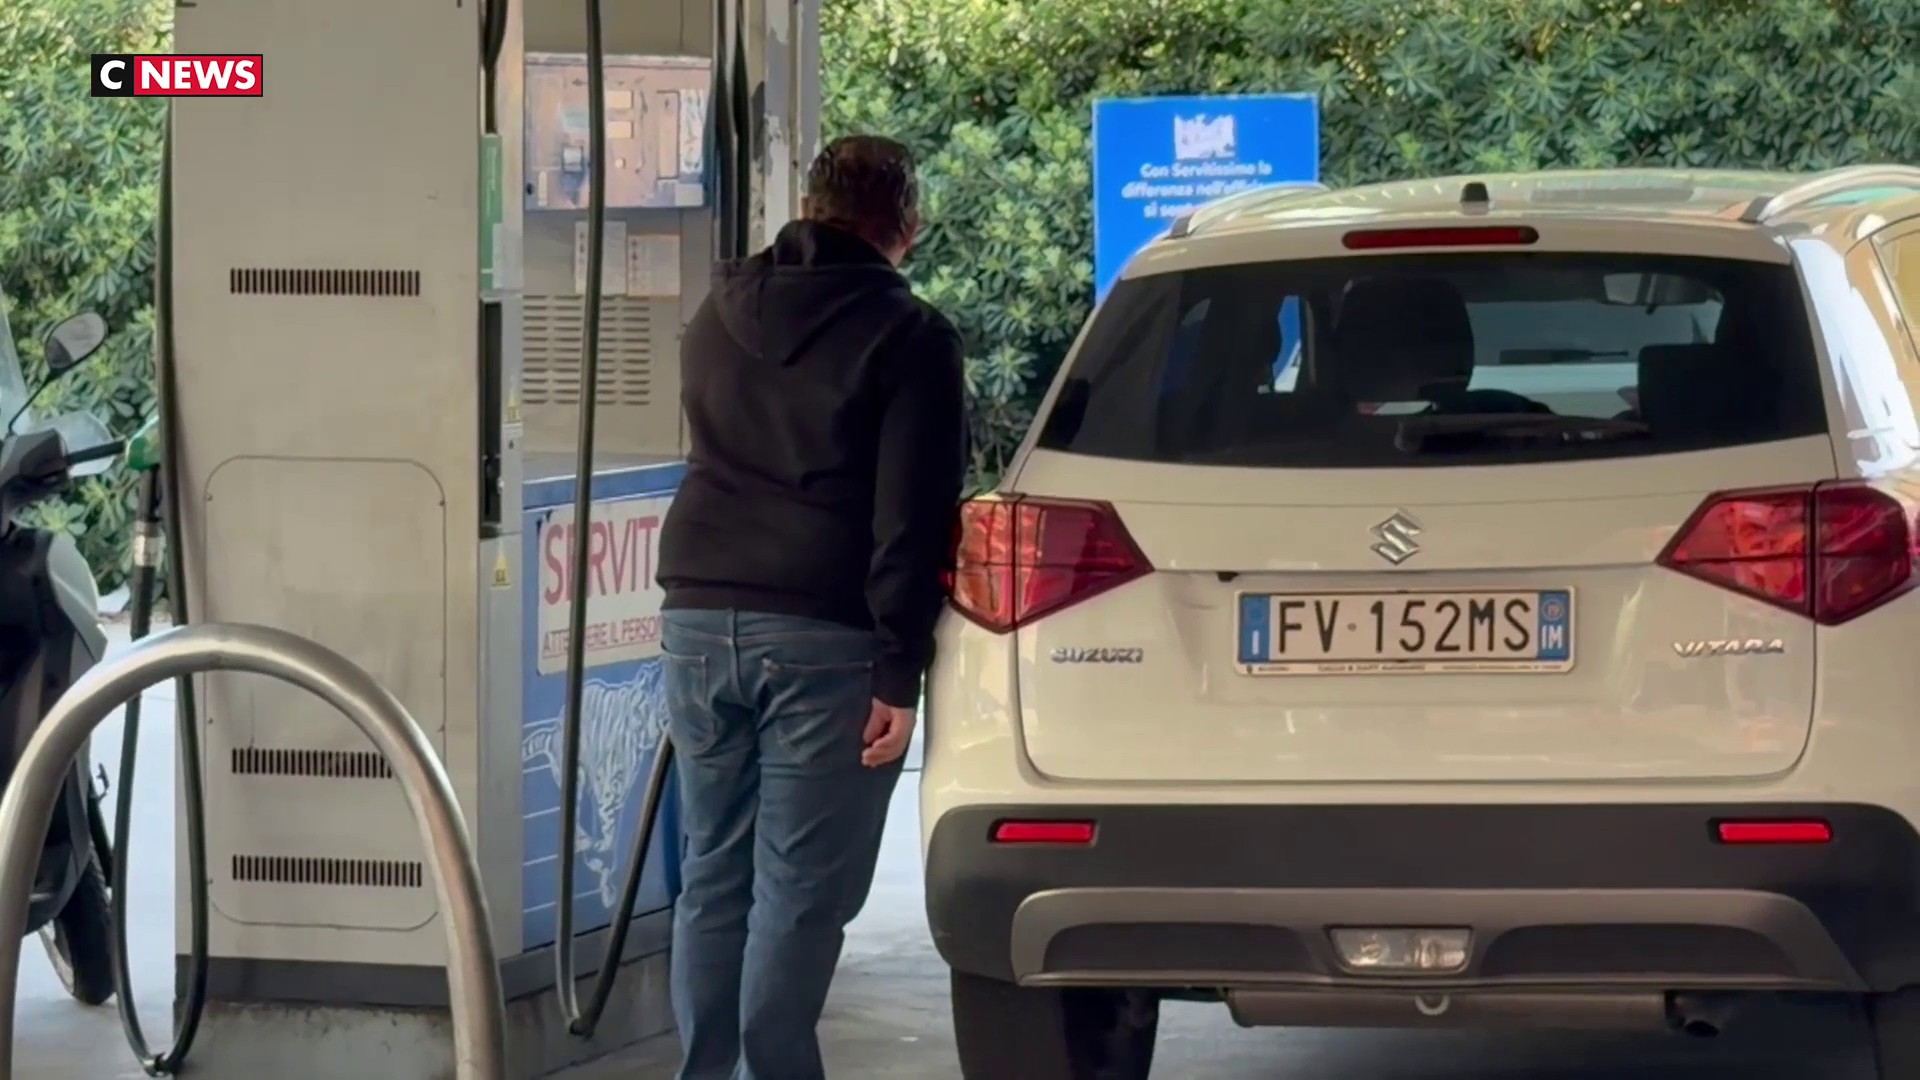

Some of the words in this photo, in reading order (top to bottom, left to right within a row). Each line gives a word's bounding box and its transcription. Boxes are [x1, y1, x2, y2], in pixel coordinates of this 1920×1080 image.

[1140, 163, 1169, 178] Con
[1279, 600, 1340, 653] FV
[1370, 598, 1531, 652] 152MS
[1541, 624, 1563, 650] IM
[1049, 646, 1144, 664] SUZUKI
[1672, 638, 1785, 658] VITARA
